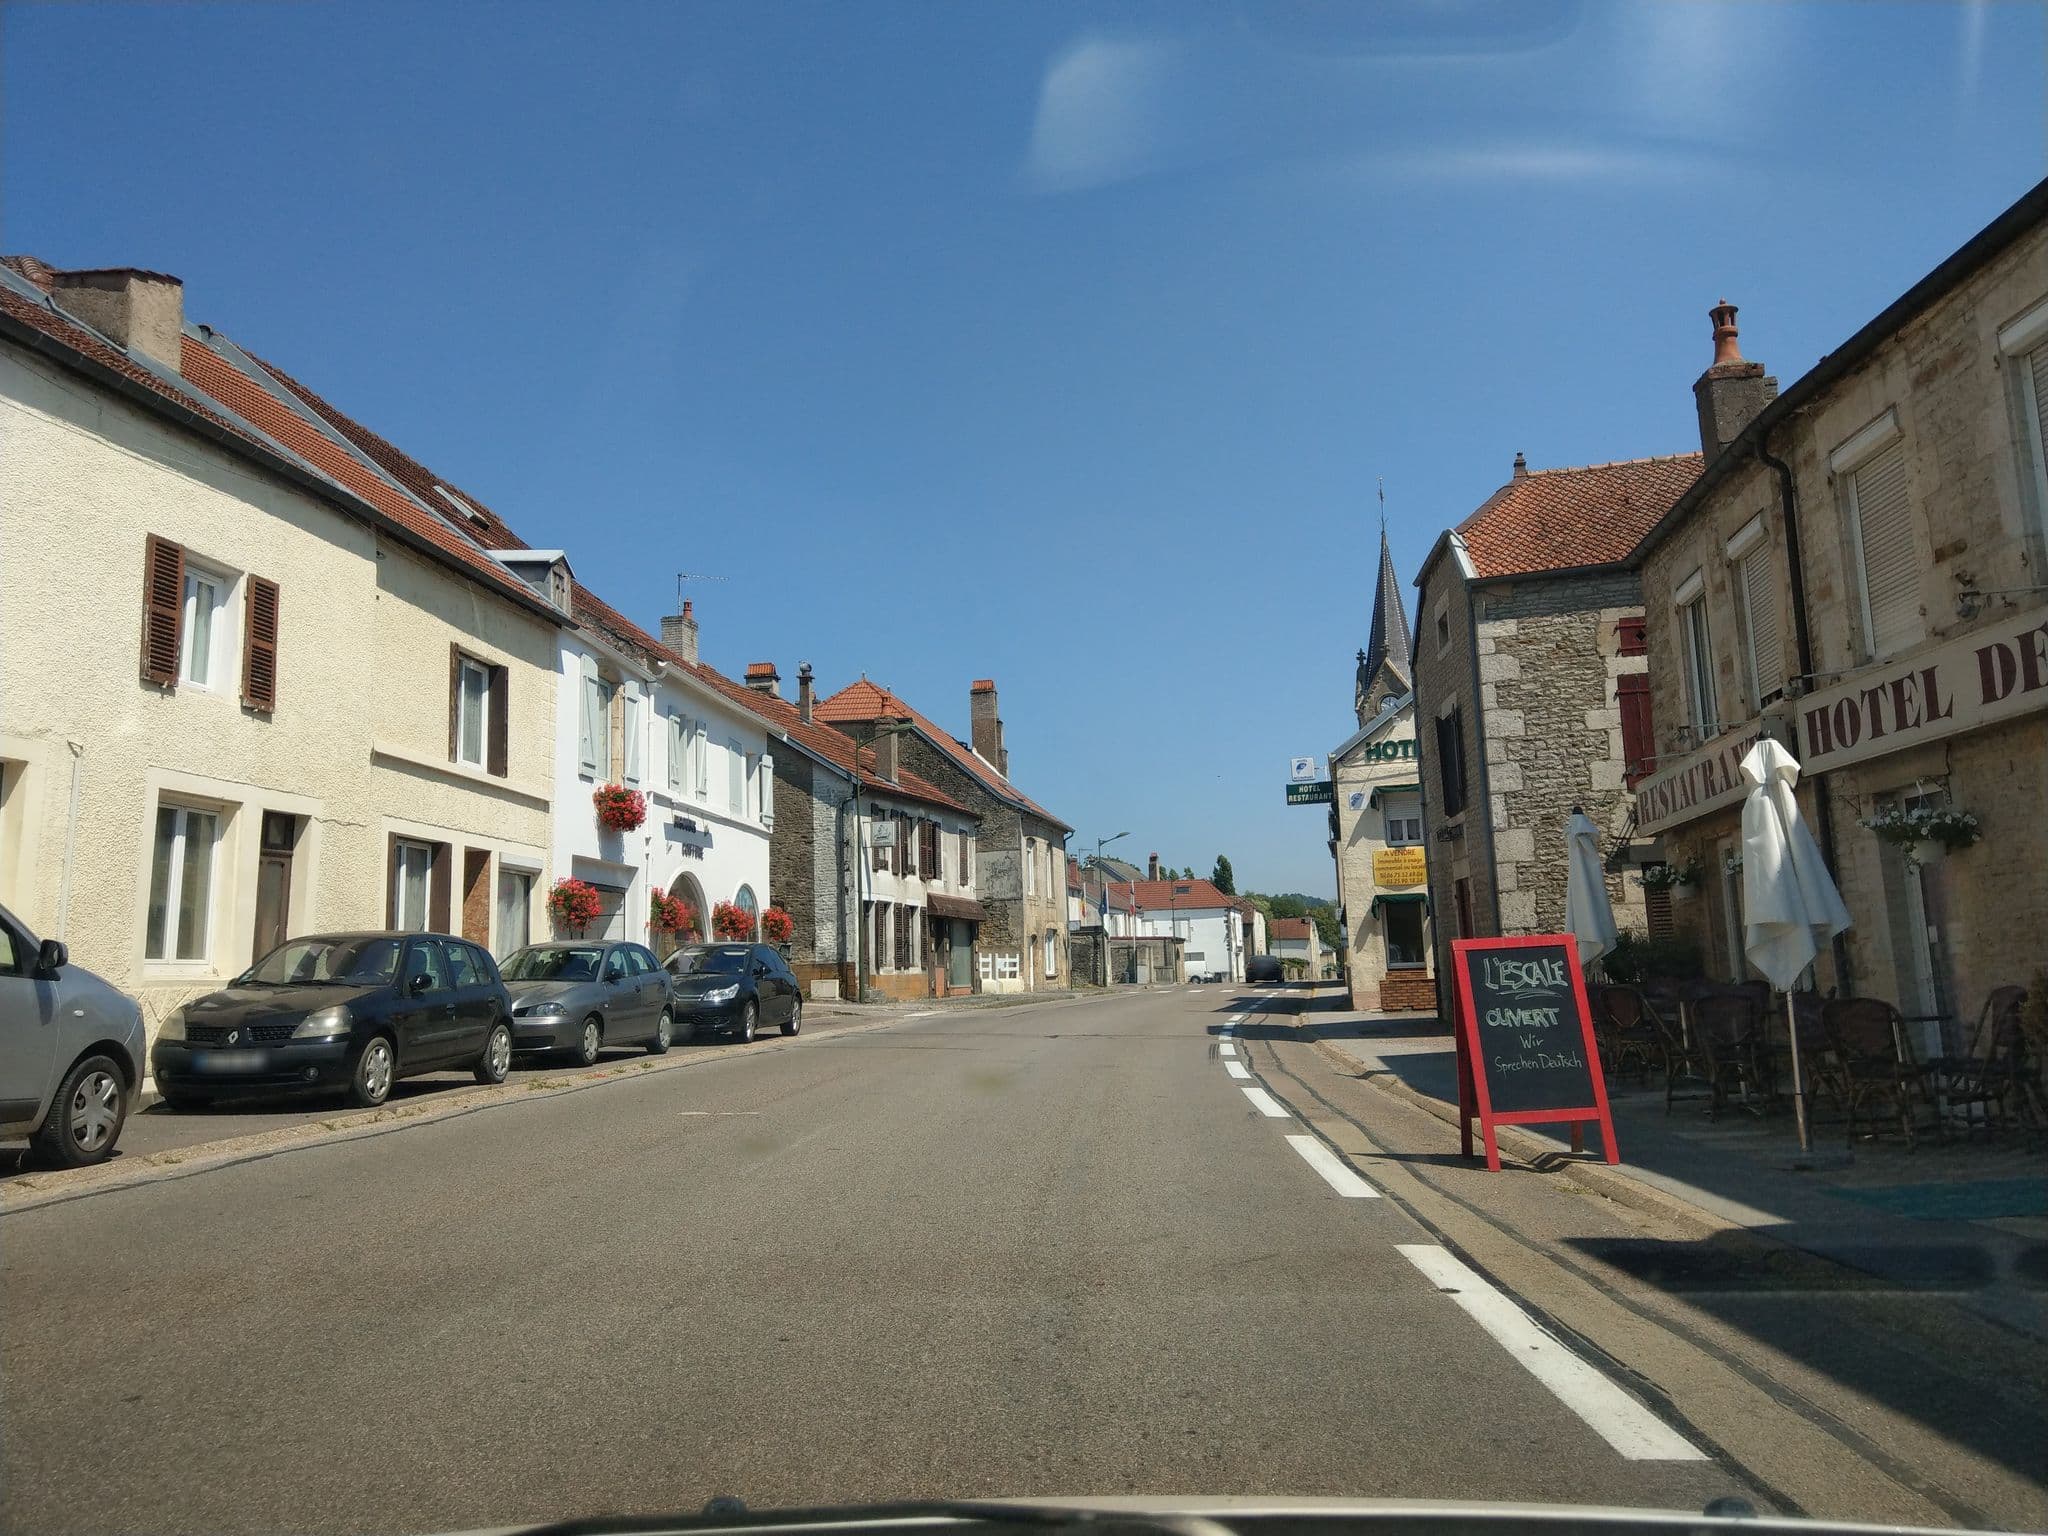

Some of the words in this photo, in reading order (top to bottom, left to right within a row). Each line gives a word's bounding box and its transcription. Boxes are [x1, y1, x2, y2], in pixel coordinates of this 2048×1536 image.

[1804, 664, 1953, 759] HOTEL
[1974, 620, 2048, 705] DE
[1288, 792, 1333, 803] RESTAURANT
[1298, 784, 1321, 793] HOTEL
[1484, 957, 1569, 990] L'ESCALE
[1485, 1007, 1560, 1028] OUVERT
[1520, 1033, 1544, 1049] Wir
[1494, 1055, 1539, 1078] Sprechen
[1538, 1051, 1583, 1070] Deutsch
